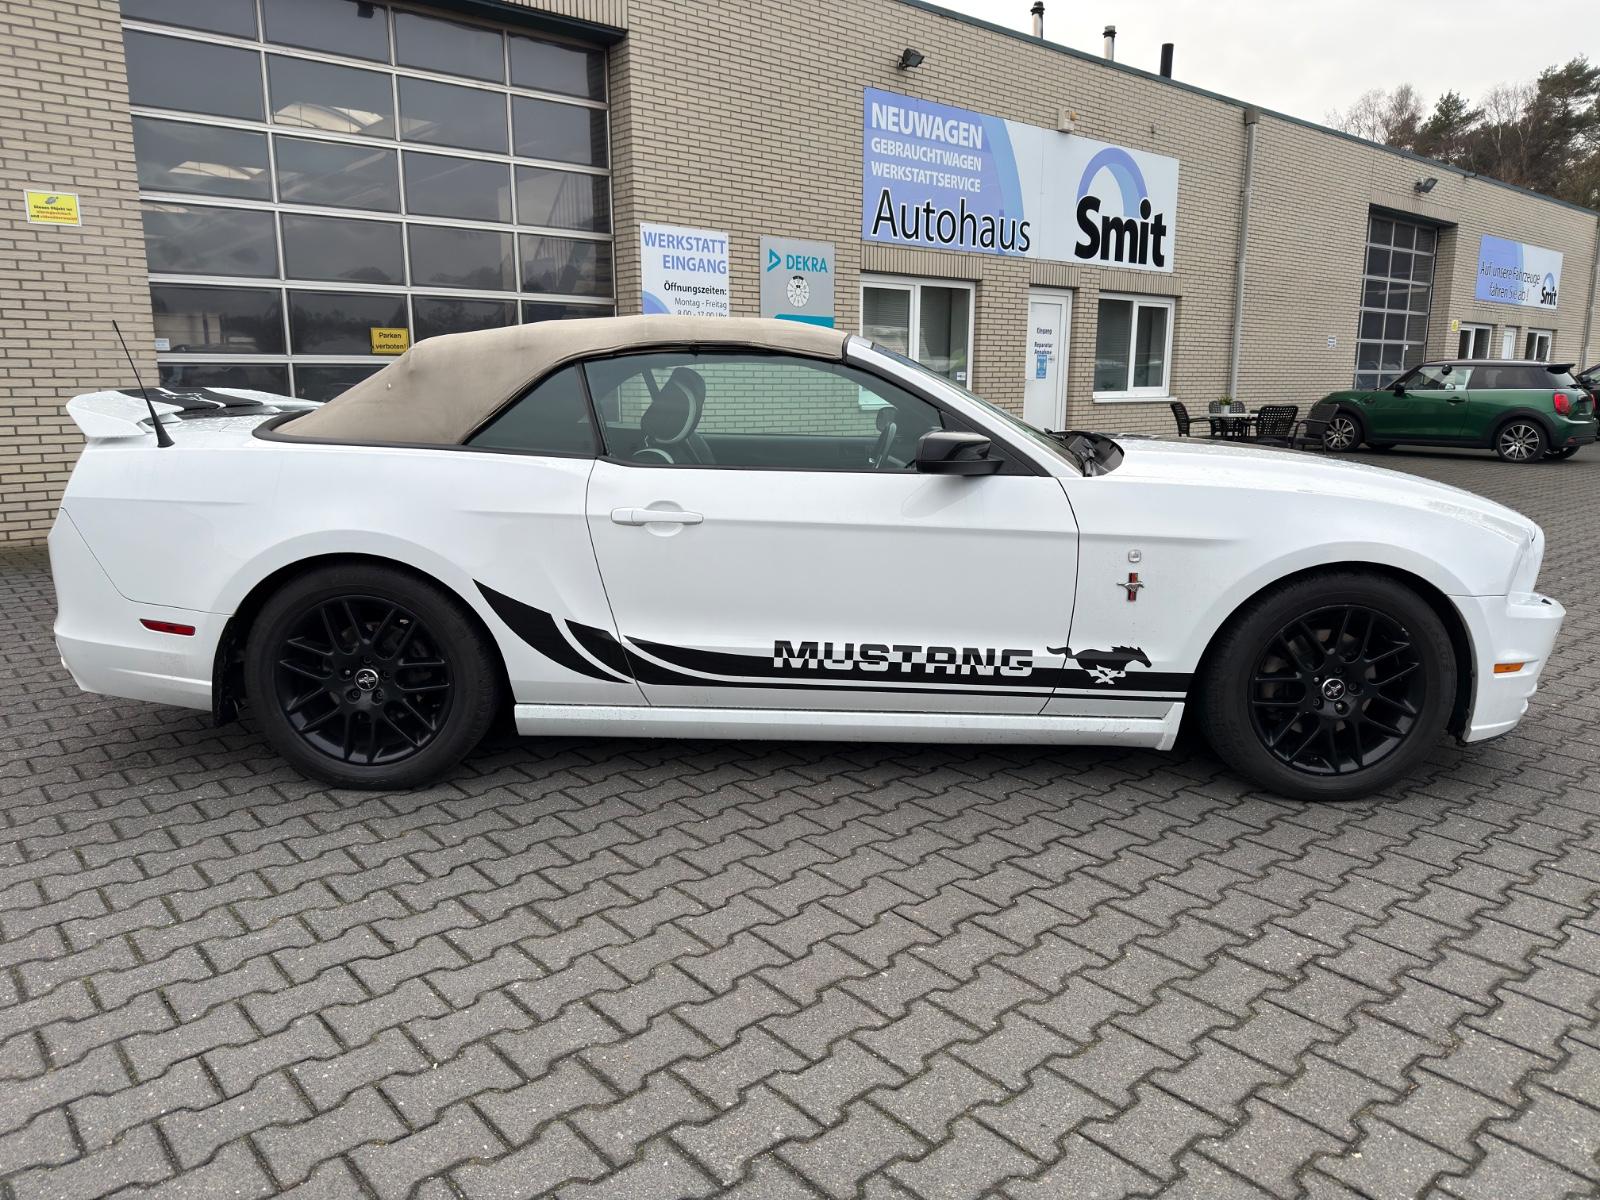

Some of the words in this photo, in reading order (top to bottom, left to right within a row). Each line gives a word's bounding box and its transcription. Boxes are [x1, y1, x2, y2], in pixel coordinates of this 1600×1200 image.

[871, 102, 982, 149] NEUWAGEN
[871, 137, 982, 172] GEBRAUCHTWAGEN
[871, 160, 981, 193] WERKSTATTSERVICE
[871, 188, 1031, 252] Autohaus
[1074, 195, 1167, 268] Smit
[642, 231, 726, 254] WERKSTATT
[662, 254, 727, 274] EINGANG
[786, 254, 828, 273] DEKRA
[1480, 261, 1492, 276] Auf
[1493, 267, 1512, 280] unsere
[1513, 266, 1540, 287] Fahrzeuge
[664, 280, 727, 295] Öffnungszeiten:
[1489, 282, 1508, 298] fahren
[1508, 285, 1517, 300] Sie
[1540, 286, 1557, 306] Smit
[674, 297, 700, 309] Montag
[705, 299, 727, 311] Freitag
[1036, 327, 1052, 336] Eingang
[773, 640, 1033, 678] MUSTANG
